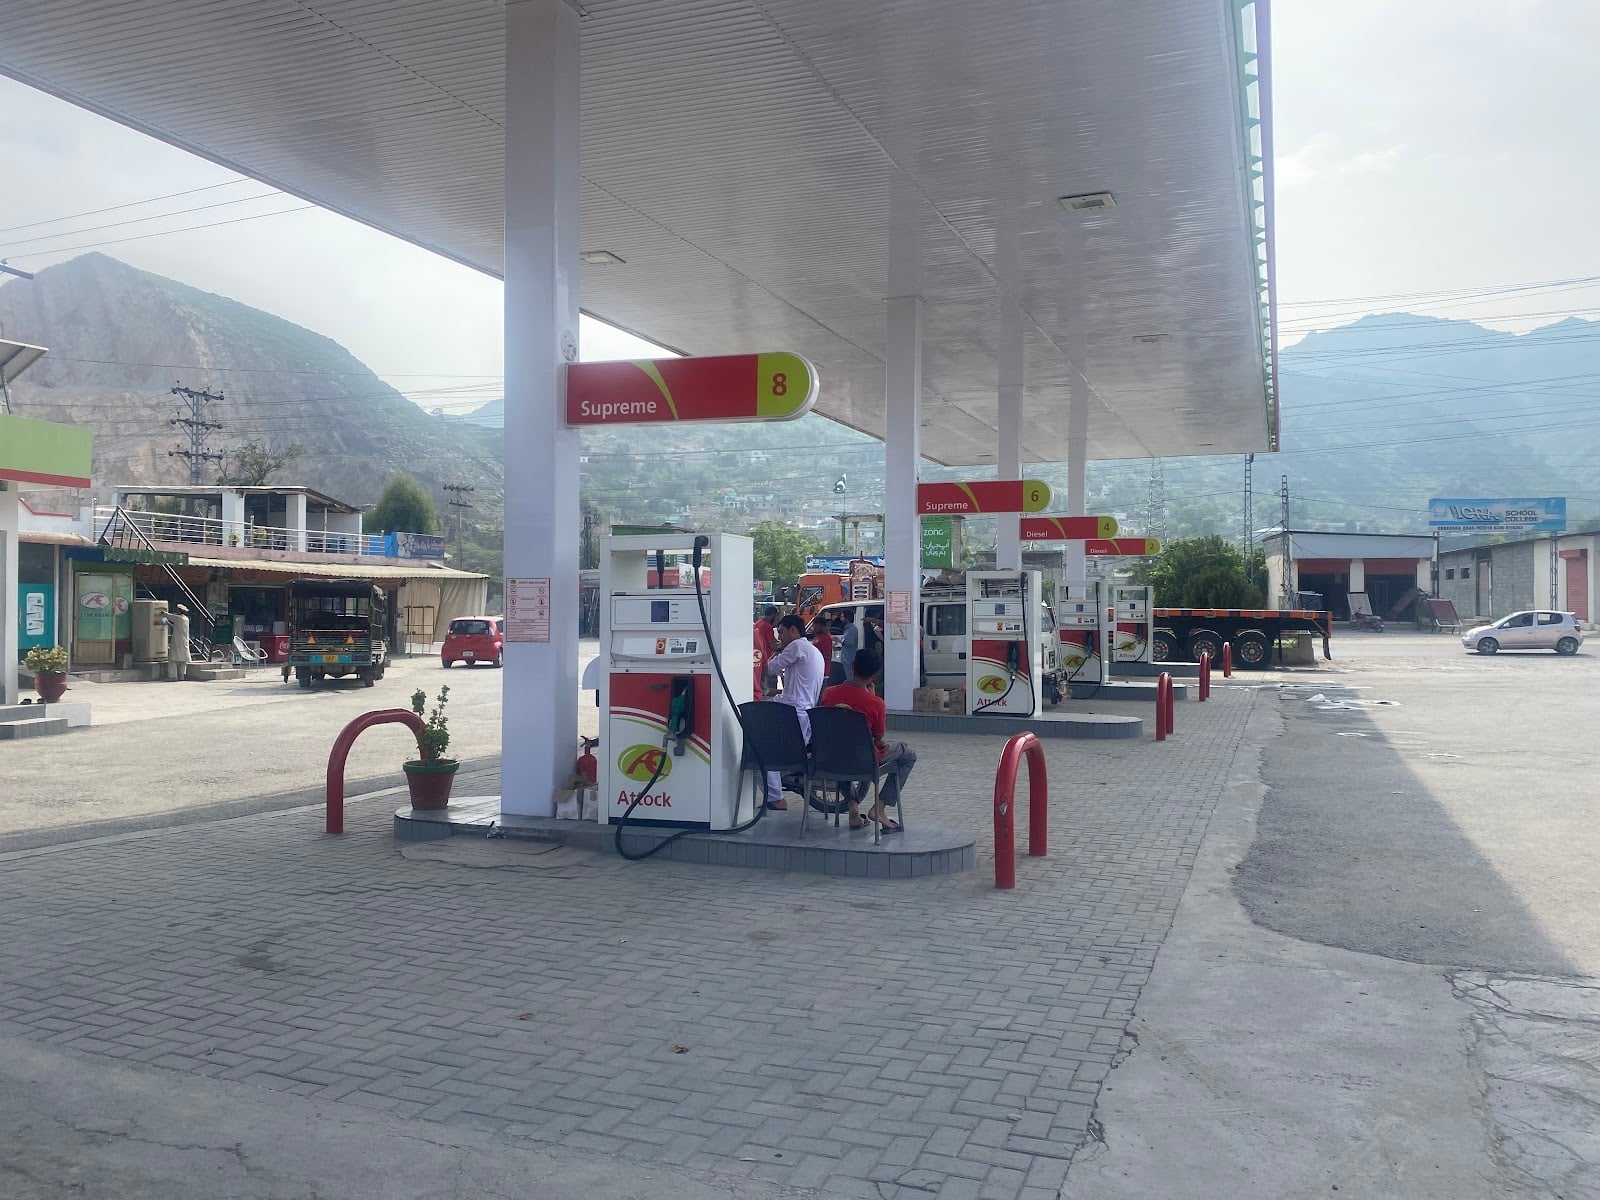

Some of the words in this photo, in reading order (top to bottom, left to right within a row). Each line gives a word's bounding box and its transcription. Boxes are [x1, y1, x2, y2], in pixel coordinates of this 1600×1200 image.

[771, 372, 787, 396] 8
[580, 399, 657, 419] Supreme
[1030, 489, 1040, 502] 6
[925, 500, 969, 514] Supreme
[1103, 523, 1110, 532] 4
[1026, 530, 1048, 539] Diesel
